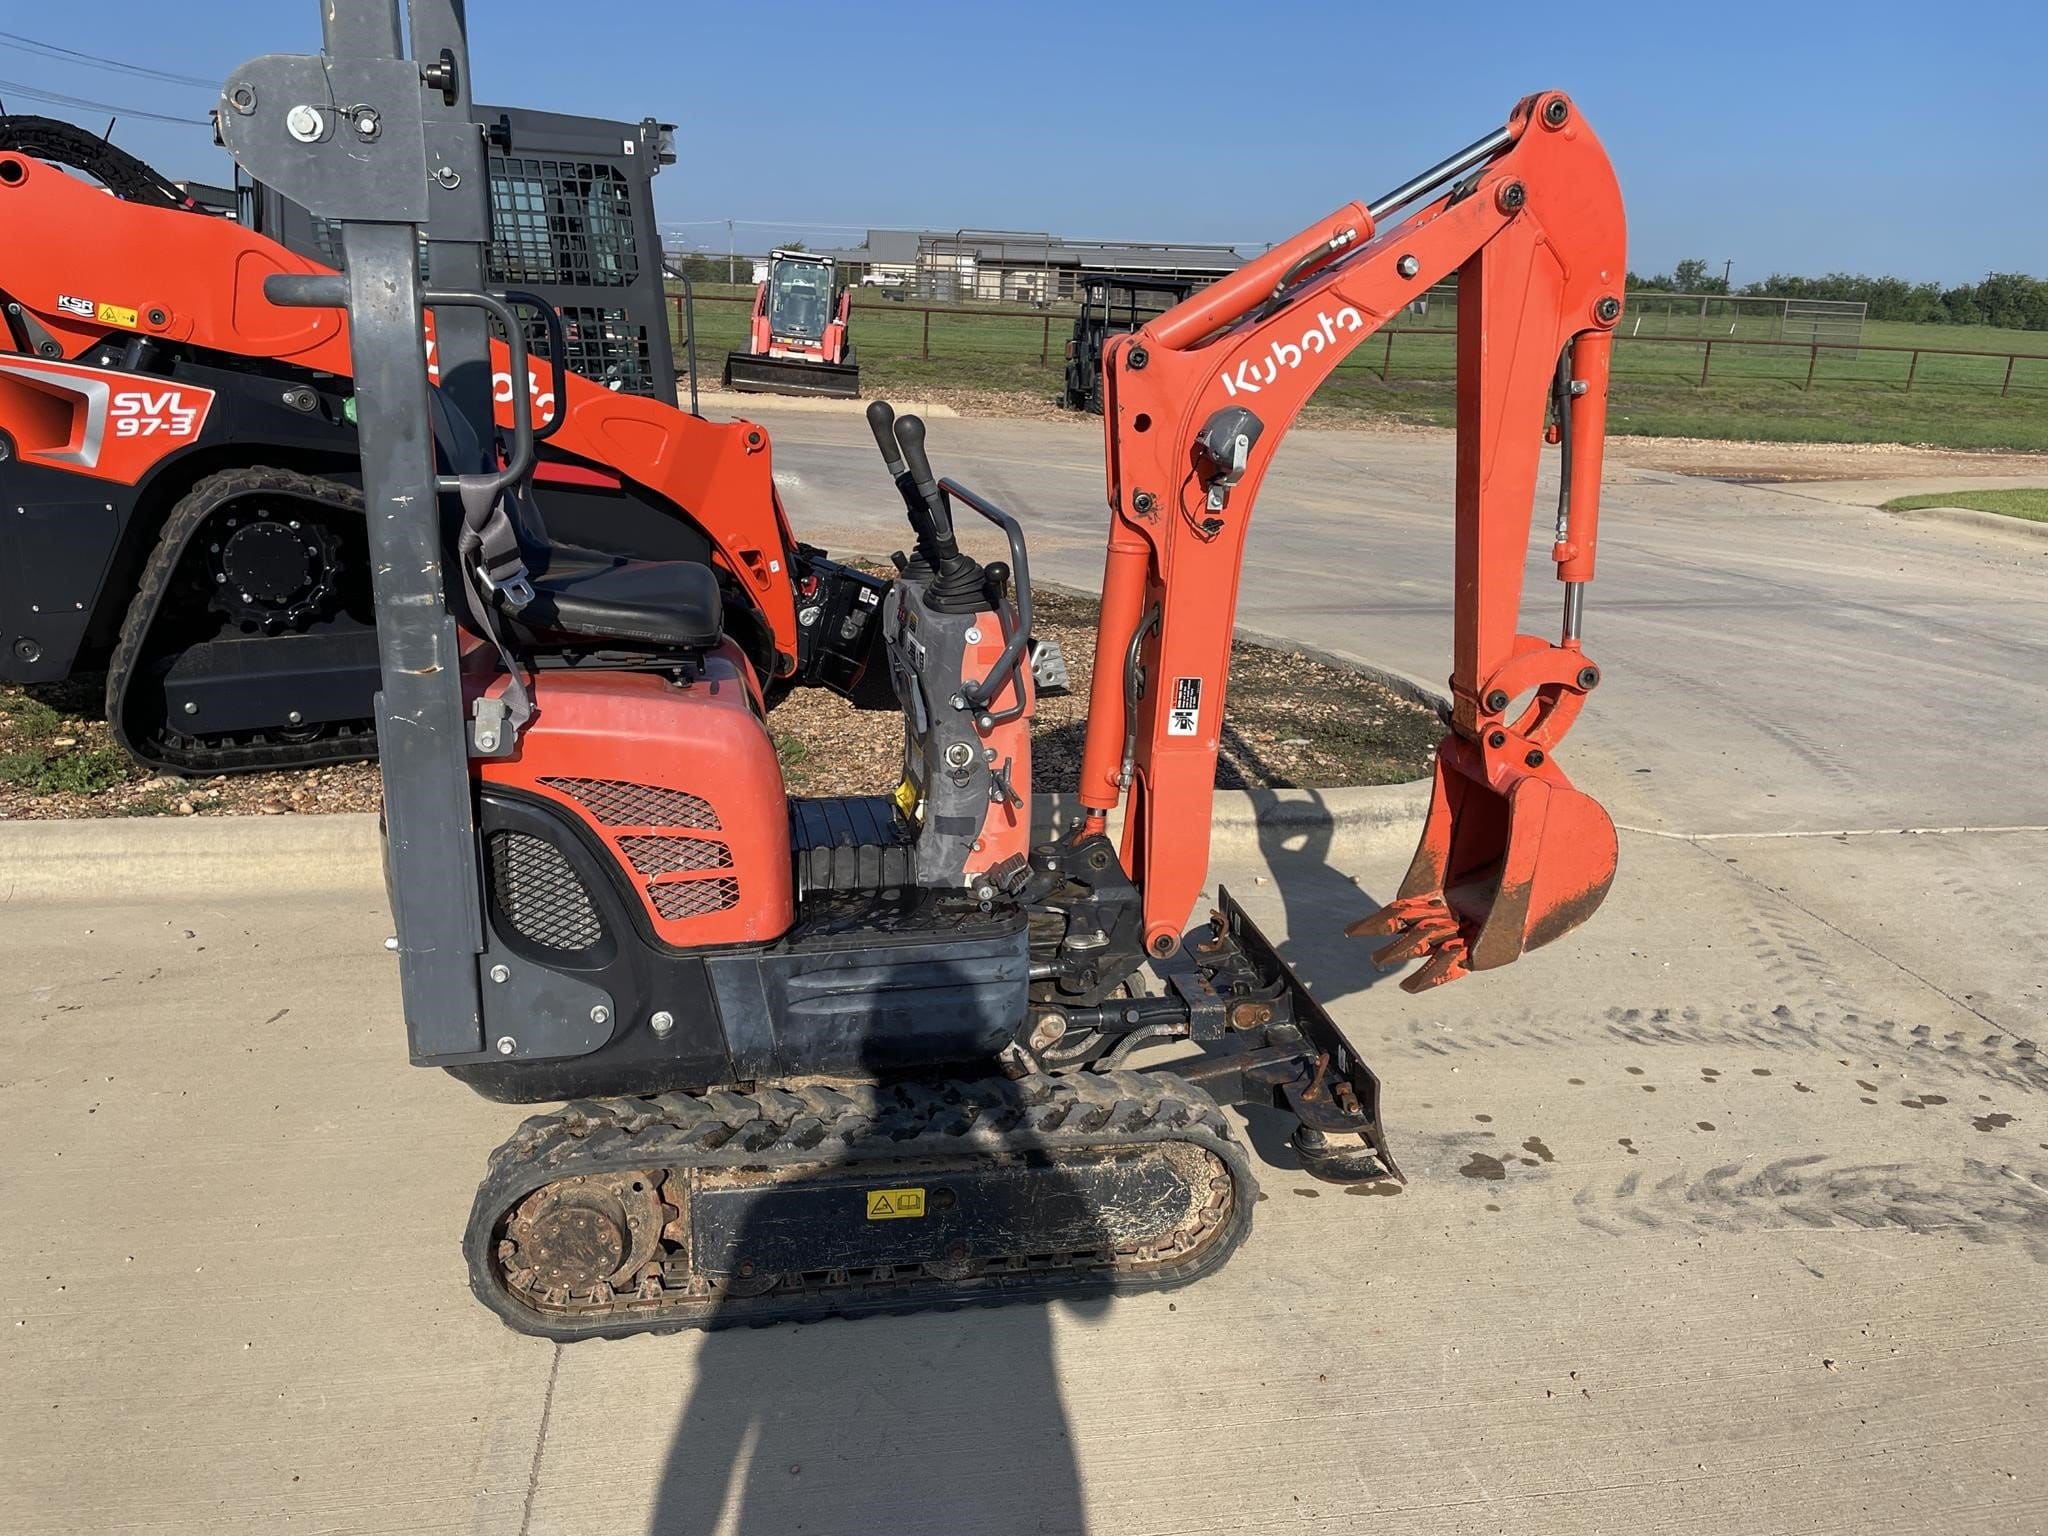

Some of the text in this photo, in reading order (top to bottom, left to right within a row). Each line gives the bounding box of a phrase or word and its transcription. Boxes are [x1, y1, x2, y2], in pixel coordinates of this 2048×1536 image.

[57, 294, 94, 313] KSR
[1220, 307, 1363, 396] Kubota
[110, 392, 196, 415] SVL
[116, 418, 192, 436] 97-3
